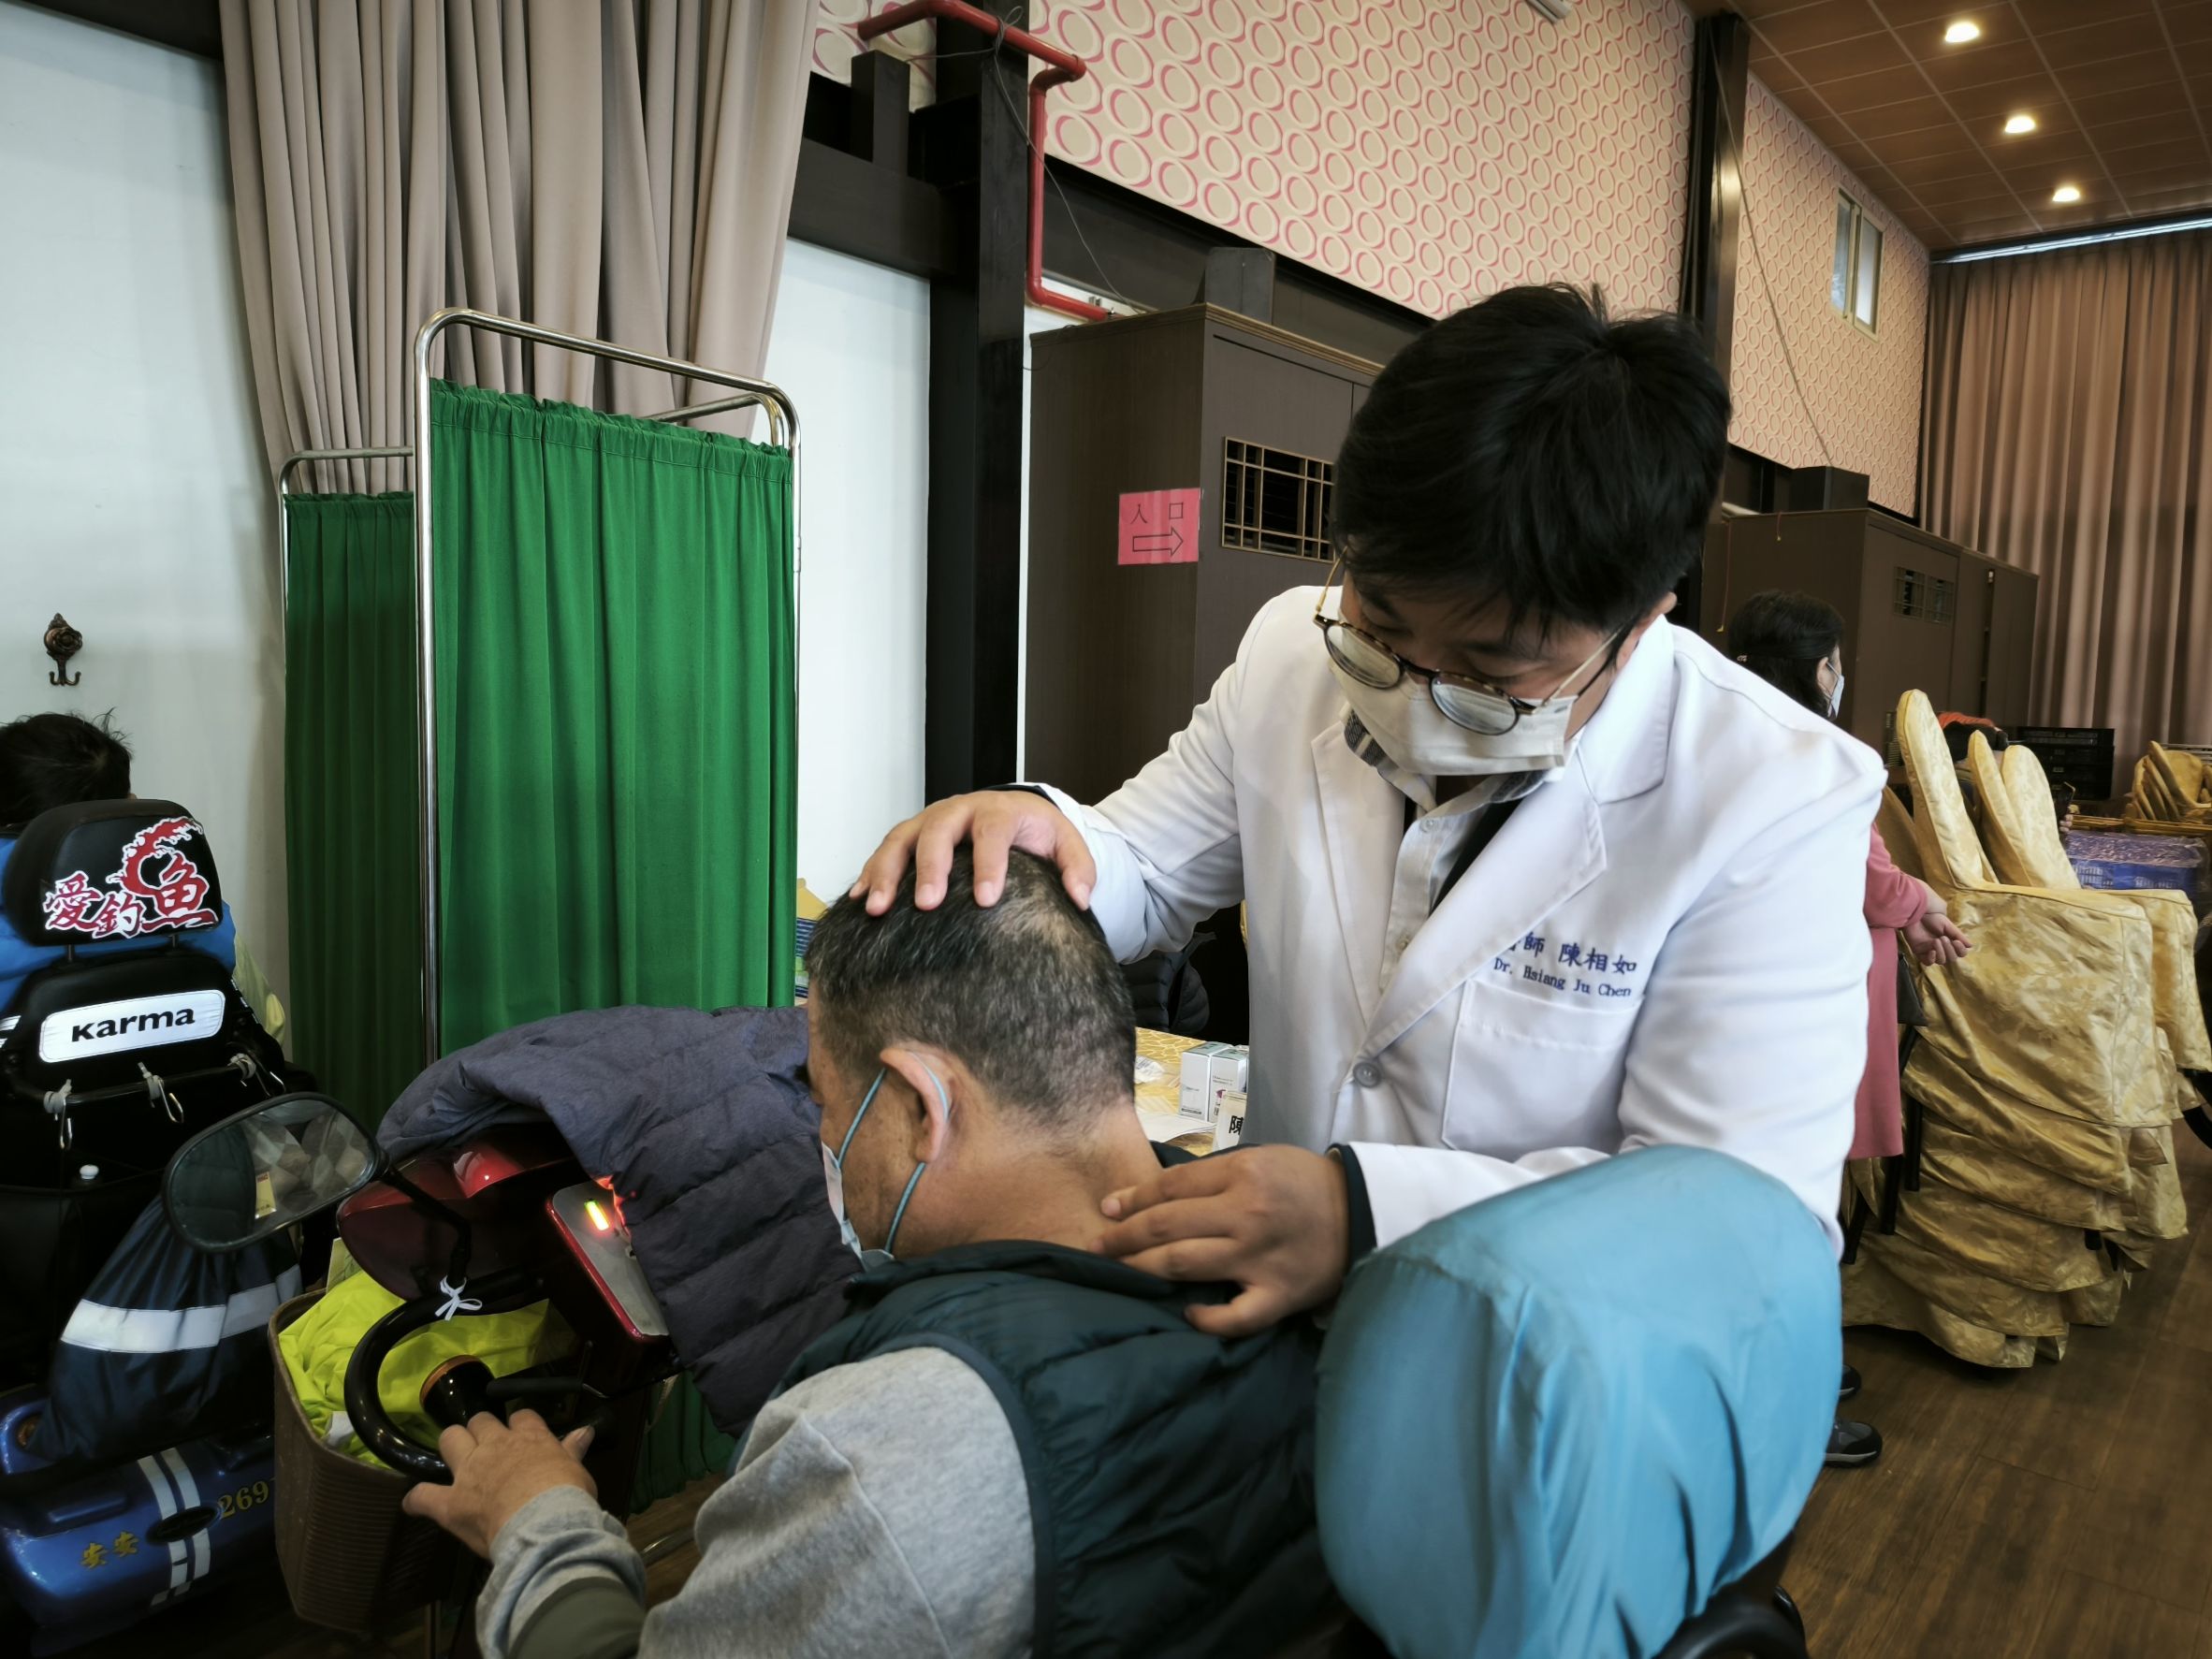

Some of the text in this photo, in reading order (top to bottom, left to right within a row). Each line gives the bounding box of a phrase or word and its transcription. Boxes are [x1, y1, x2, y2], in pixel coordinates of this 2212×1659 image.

[1130, 502, 1184, 524] 入口
[43, 816, 221, 939] 愛釣魚
[1558, 942, 1637, 975] 陳相如
[1493, 957, 1631, 997] Dr. Hsiang Ju Chen
[71, 1007, 196, 1042] karma
